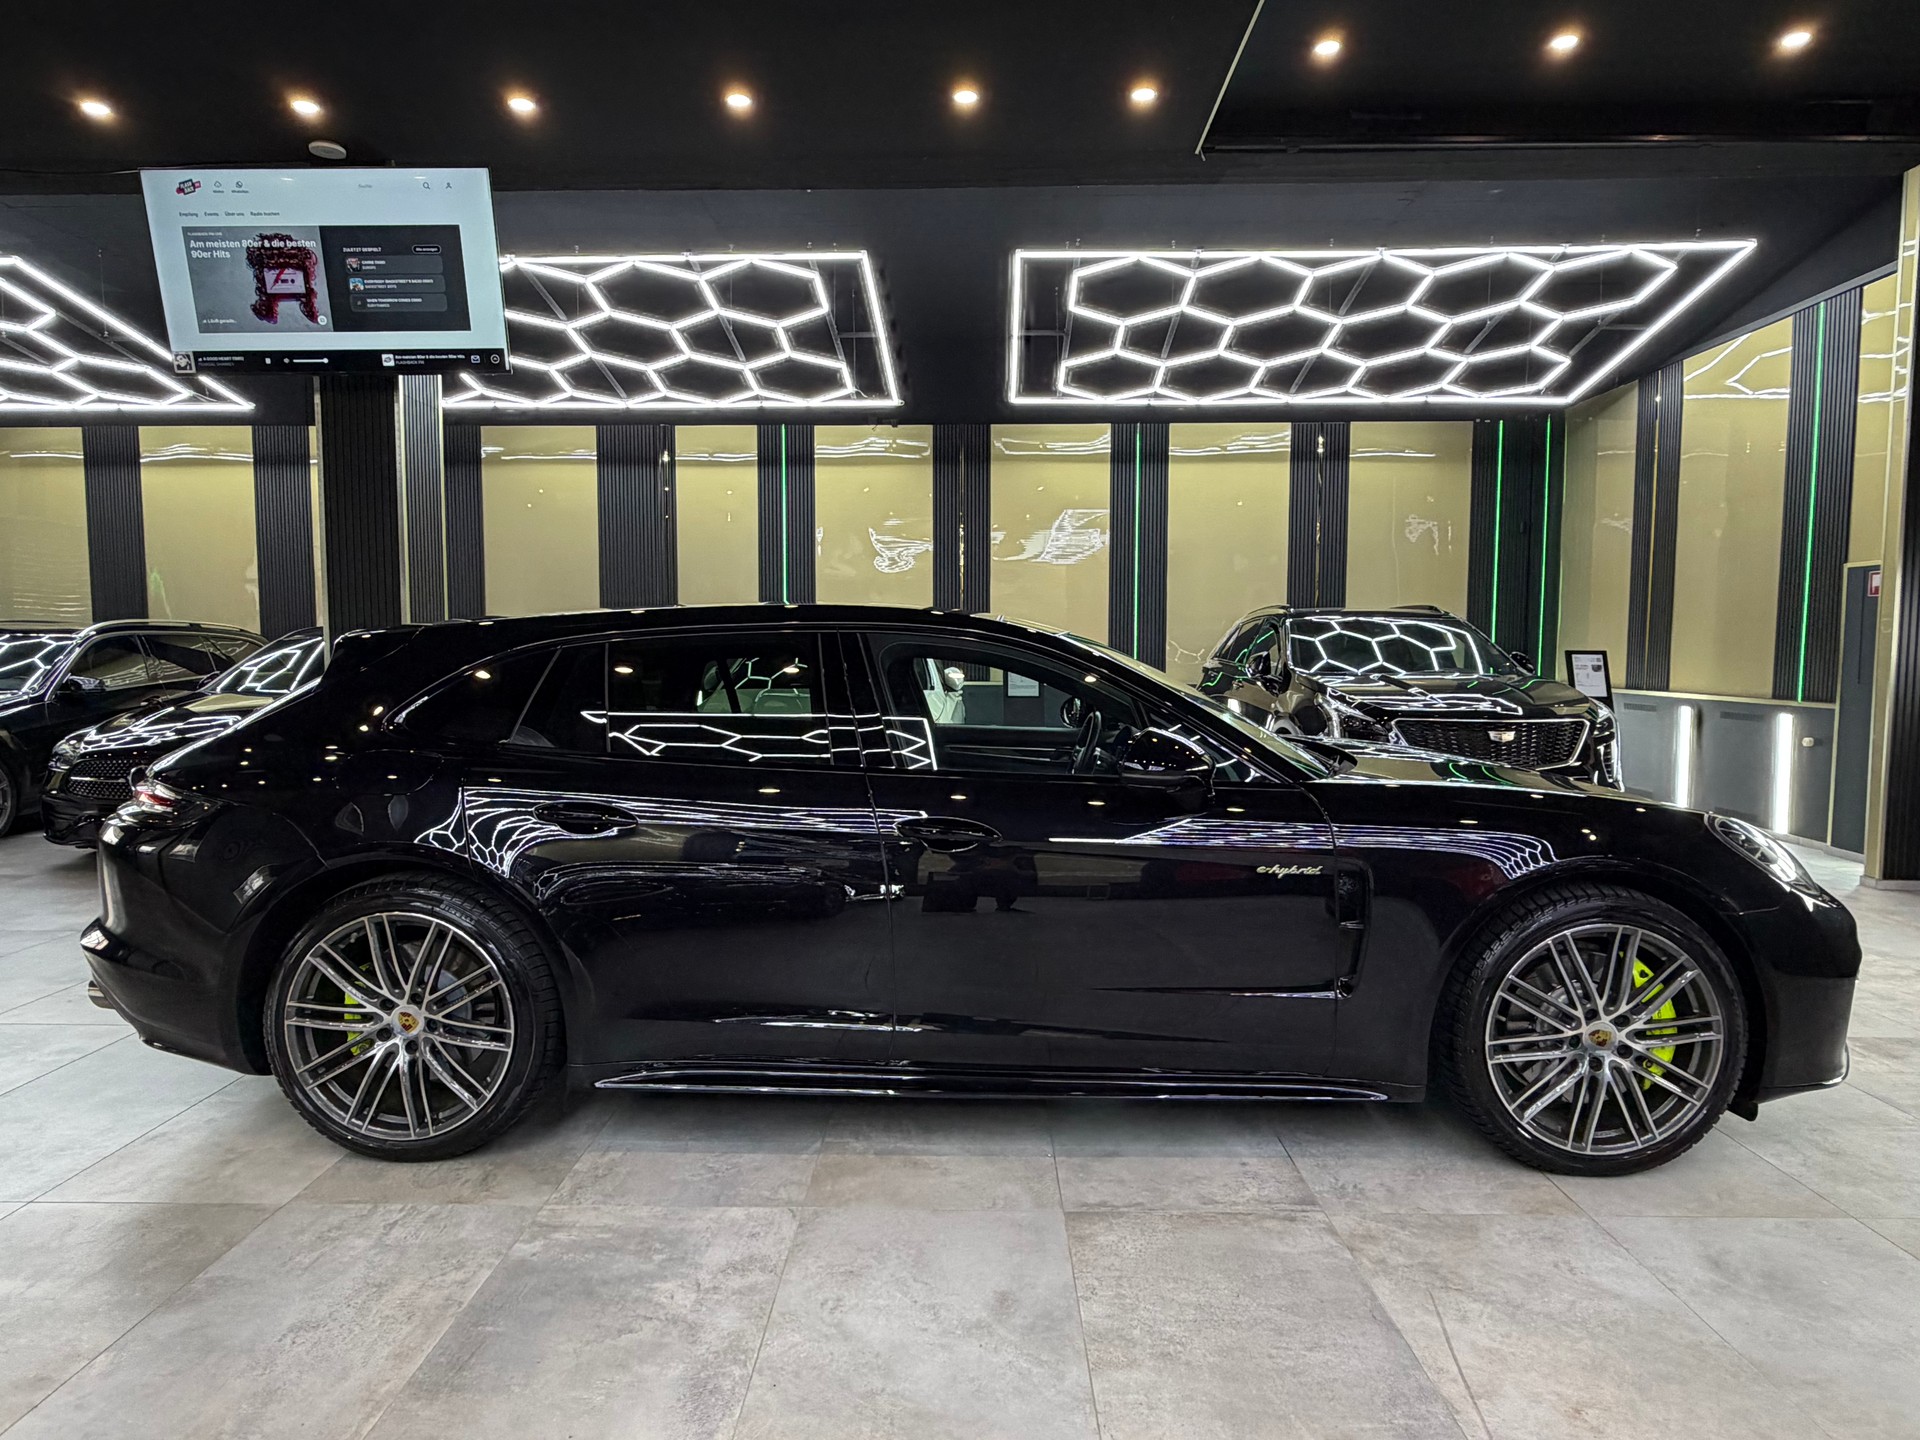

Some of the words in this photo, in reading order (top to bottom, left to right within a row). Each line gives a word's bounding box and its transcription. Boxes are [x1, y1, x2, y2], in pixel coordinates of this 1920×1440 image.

[190, 240, 204, 248] Am
[206, 240, 240, 248] meisten
[242, 240, 262, 248] 80er
[264, 240, 270, 248] &
[272, 240, 284, 248] die
[286, 240, 316, 248] besten
[191, 250, 211, 258] 90er
[213, 250, 231, 258] Hits
[1256, 864, 1323, 879] e-hybrid
